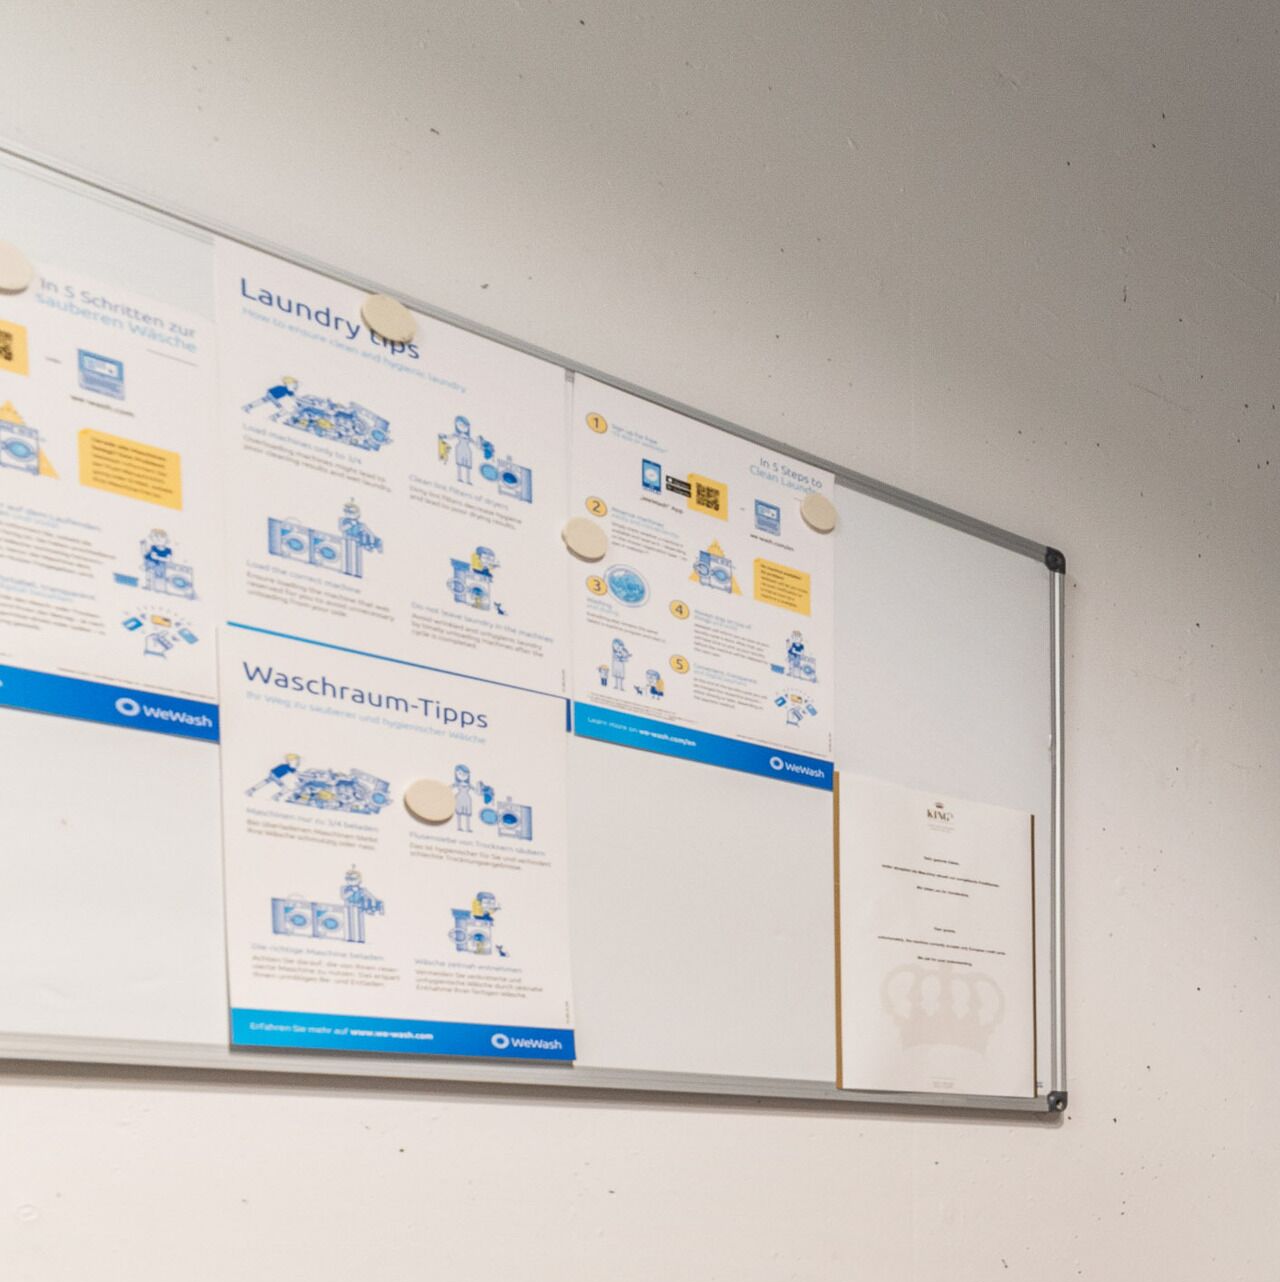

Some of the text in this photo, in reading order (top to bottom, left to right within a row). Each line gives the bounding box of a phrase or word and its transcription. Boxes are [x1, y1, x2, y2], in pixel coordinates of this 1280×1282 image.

[39, 275, 196, 340] In 5 Schritten zur
[240, 277, 361, 341] Laundry
[593, 417, 600, 429] 1
[750, 464, 816, 494] Clean Laundr
[759, 456, 822, 489] In 5 Steps to
[592, 501, 601, 512] 2
[592, 580, 601, 591] 3
[675, 604, 684, 616] 4
[676, 659, 684, 670] 5
[242, 661, 489, 729] Waschraum-Tipps
[142, 704, 213, 728] WeWash
[784, 761, 825, 779] WeWash
[511, 1036, 562, 1051] WeWash
